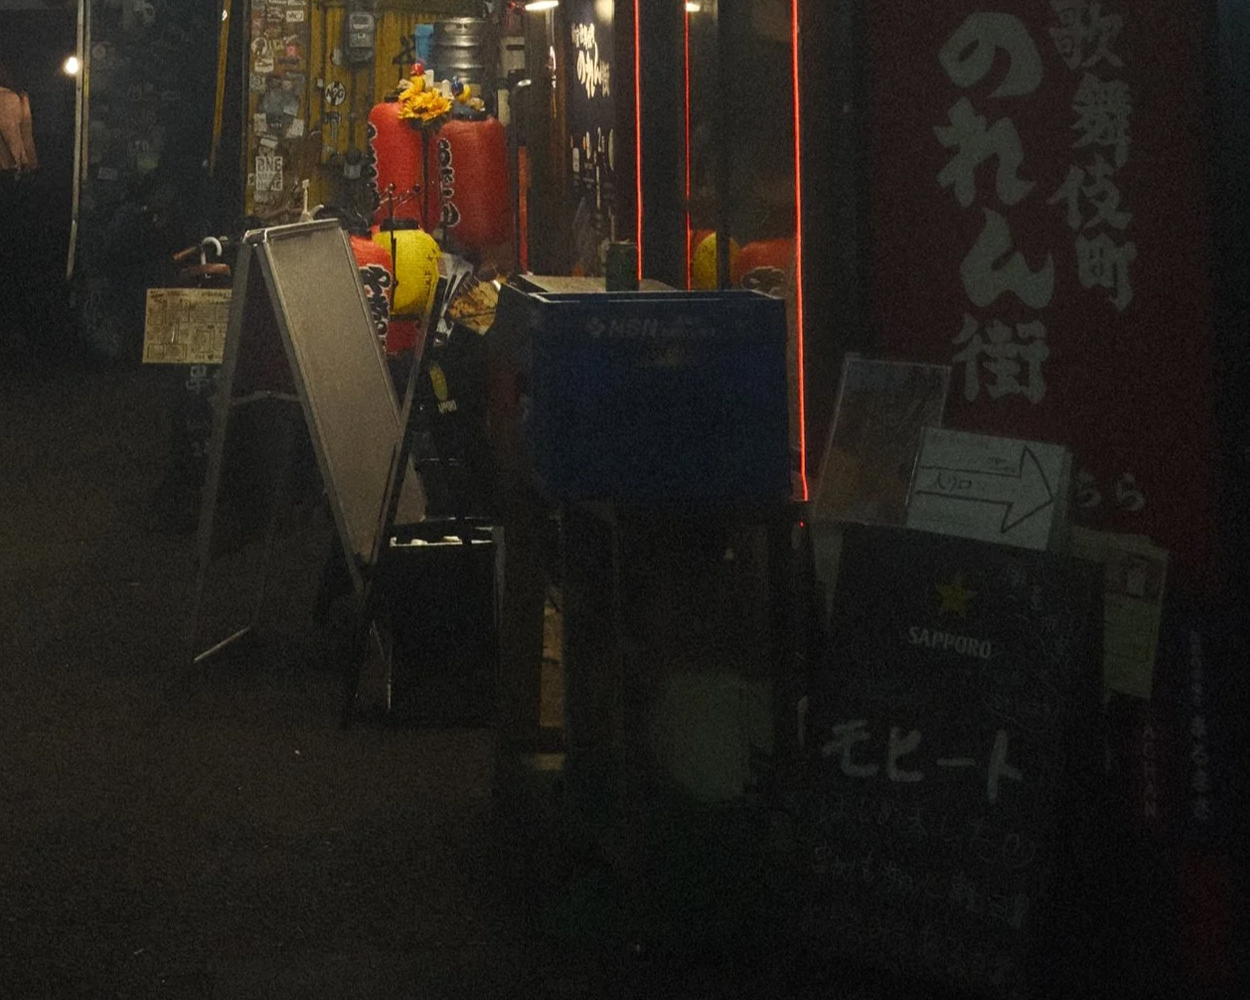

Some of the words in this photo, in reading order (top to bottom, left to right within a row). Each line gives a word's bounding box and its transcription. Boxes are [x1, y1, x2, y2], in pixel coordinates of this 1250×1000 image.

[932, 10, 1055, 406] のれん街
[907, 625, 993, 662] SAPPORO
